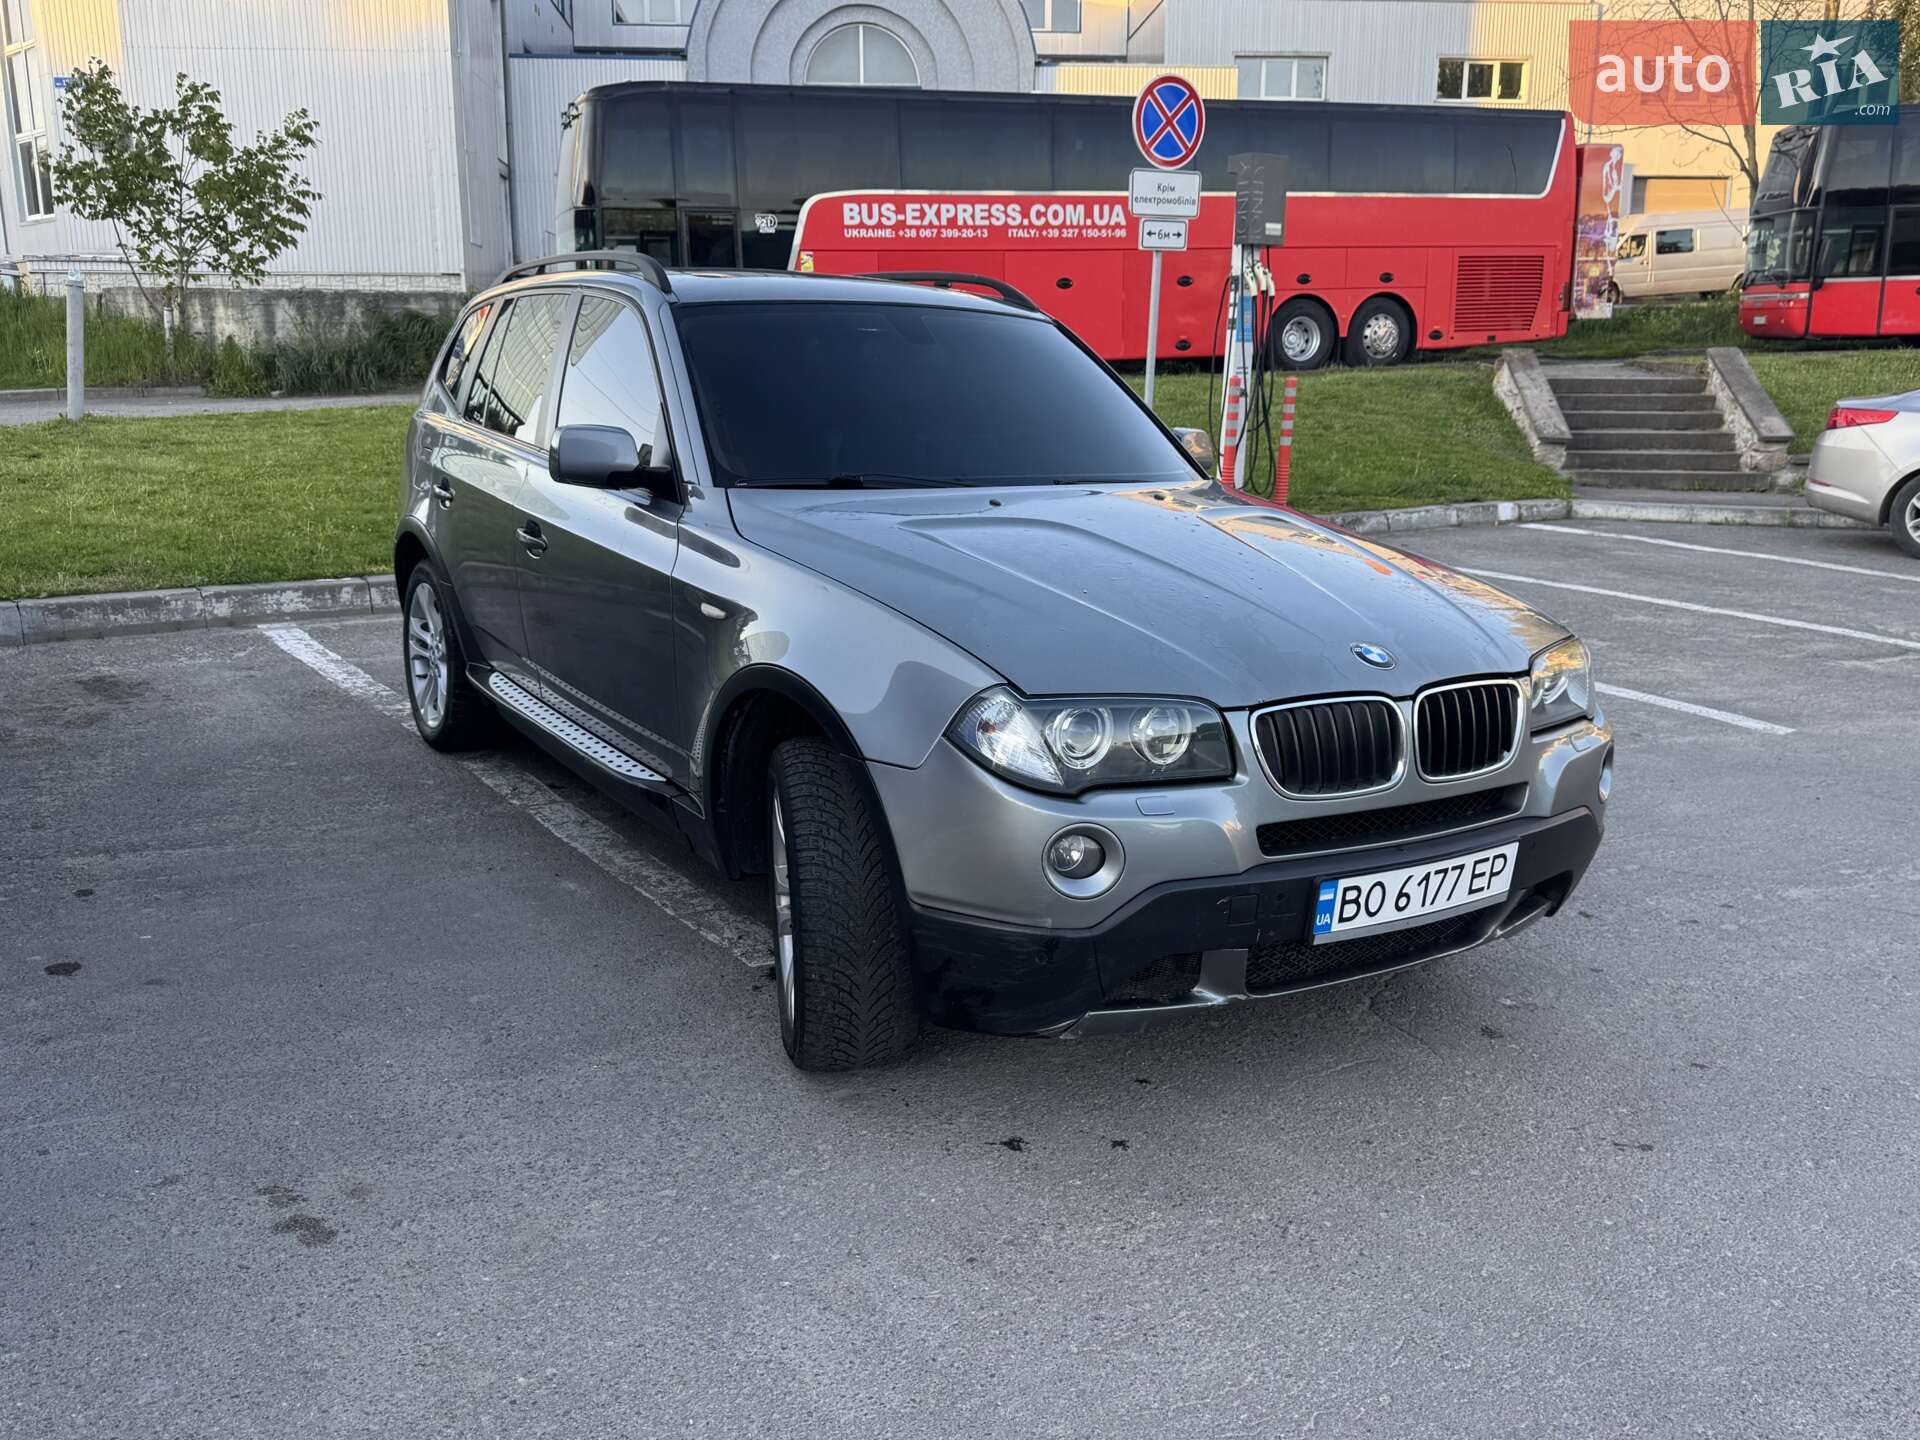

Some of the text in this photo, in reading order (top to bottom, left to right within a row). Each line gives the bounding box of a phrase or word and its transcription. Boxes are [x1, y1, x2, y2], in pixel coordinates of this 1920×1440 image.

[1157, 183, 1176, 194] Крім
[1134, 195, 1197, 206] електромобілів
[842, 203, 1127, 226] BUS-EXPRESS.COM.UA
[844, 228, 896, 238] UKRAINE:
[898, 228, 917, 238] +38
[919, 228, 938, 238] 067
[1008, 228, 1040, 238] ITALY:
[1042, 228, 1059, 238] +39
[1061, 228, 1078, 238] 327
[1157, 229, 1171, 239] 6м
[1338, 853, 1508, 924] BO 6177 EP
[1316, 913, 1331, 926] UA
